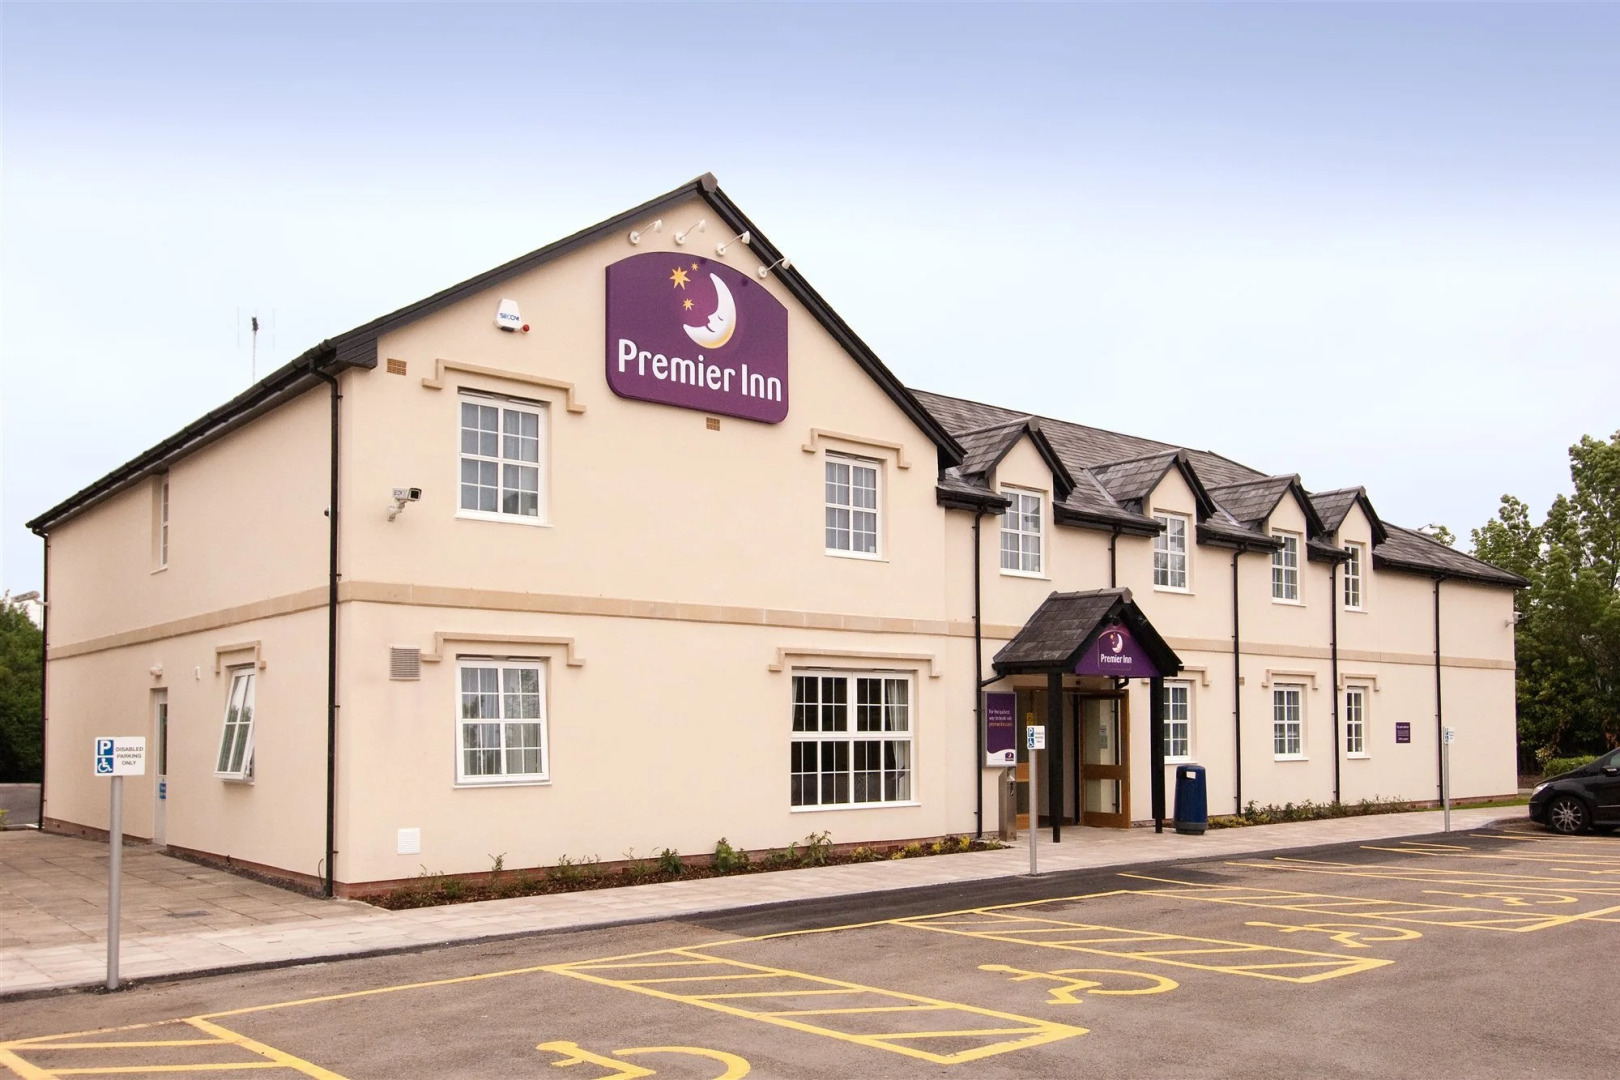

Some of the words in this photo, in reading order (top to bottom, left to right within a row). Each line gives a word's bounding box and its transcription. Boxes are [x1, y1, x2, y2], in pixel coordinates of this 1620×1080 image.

[618, 338, 736, 392] Premier
[741, 363, 782, 402] Inn
[1100, 653, 1123, 664] Premier
[1123, 654, 1132, 664] Inn
[100, 740, 112, 755] P
